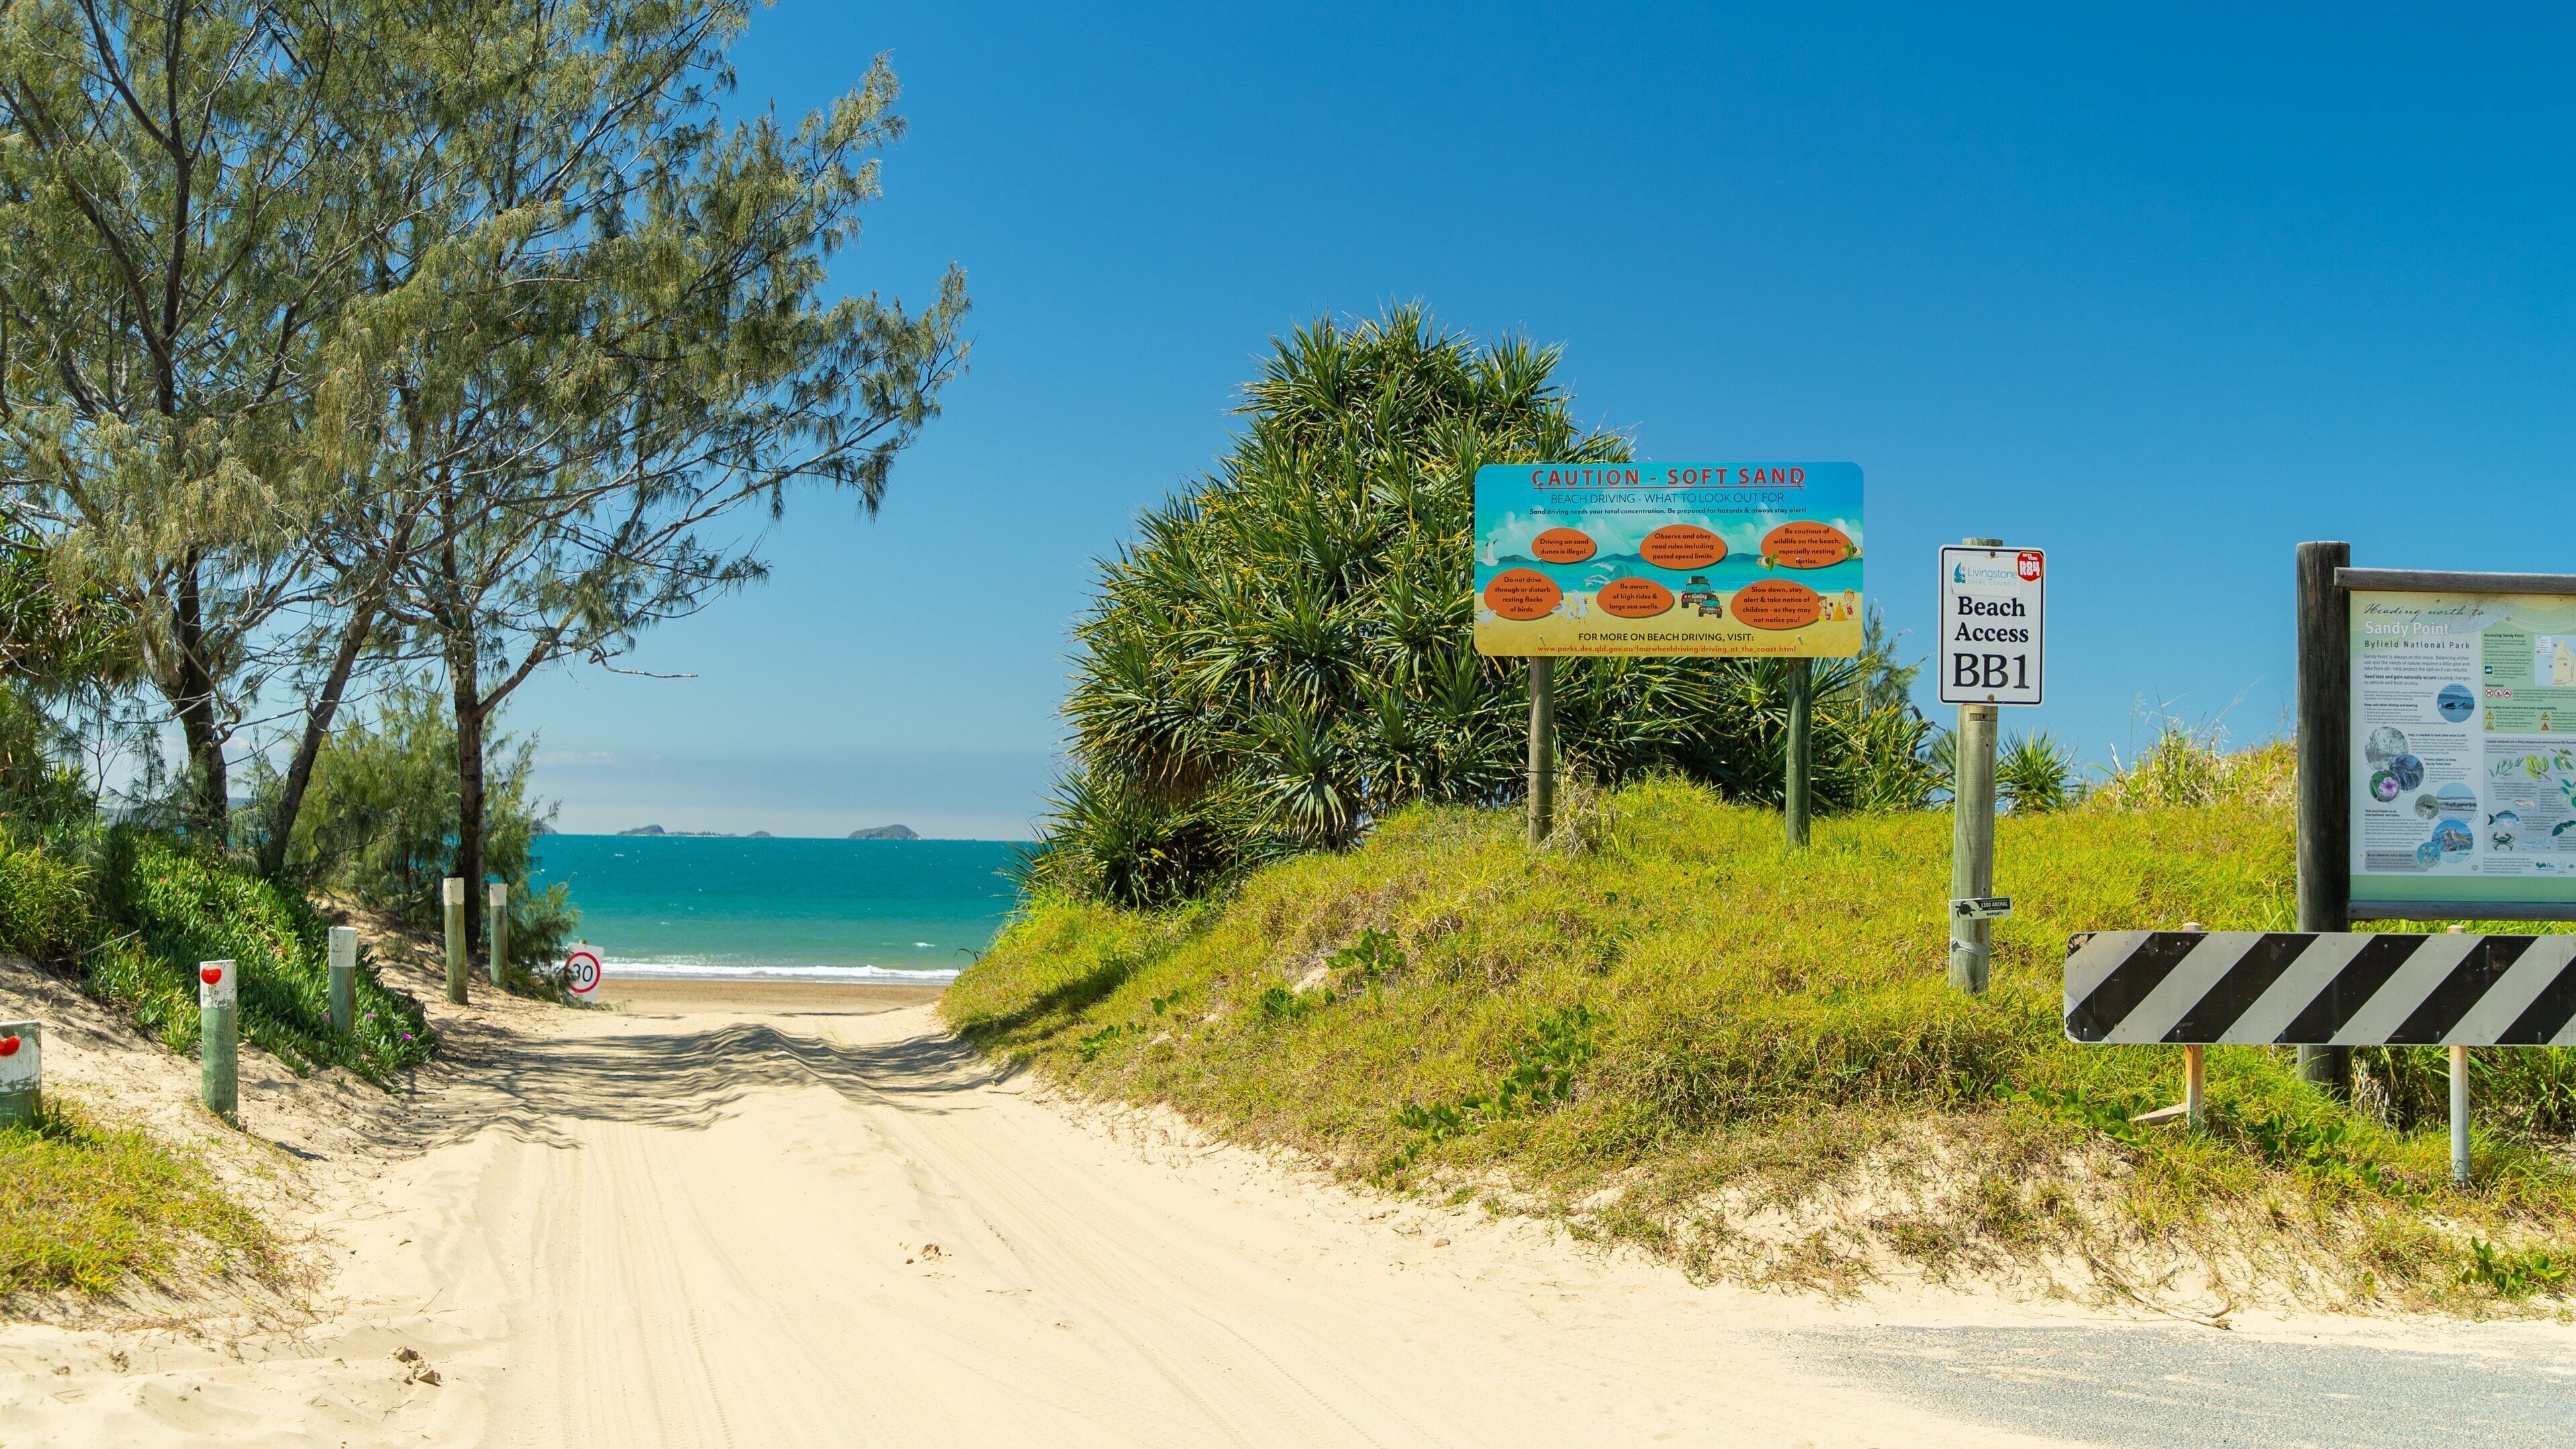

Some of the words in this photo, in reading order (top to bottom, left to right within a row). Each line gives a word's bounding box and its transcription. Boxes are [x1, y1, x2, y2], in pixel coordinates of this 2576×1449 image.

[1532, 470, 1639, 486] CAUTION
[1667, 468, 1728, 484] SOFT
[1738, 468, 1805, 484] SAND
[1552, 494, 1587, 503] BEACH
[1591, 494, 1635, 503] DRIVING
[1644, 494, 1678, 502] WHAT
[1680, 494, 1696, 502] TO
[1700, 494, 1730, 502] LOOK
[1733, 493, 1759, 502] OUT
[1762, 493, 1784, 502] FOR
[1696, 532, 1711, 540] obey
[1795, 557, 1818, 565] turtles.
[1968, 567, 2018, 580] Livingstone
[2019, 561, 2040, 576] R84
[1789, 586, 1802, 594] stay
[1958, 596, 2025, 616] Beach
[2364, 604, 2422, 623] Heading
[2428, 606, 2466, 615] north
[2470, 608, 2484, 616] to
[1955, 622, 2029, 643] Access
[2365, 621, 2408, 637] Sandy
[2413, 622, 2449, 635] Point
[1682, 633, 1725, 641] DRIVING,
[1538, 645, 1796, 653] www.parks.des.qld.gov.au/fourwheeldriving/driving_at_the_coast.html
[2365, 640, 2398, 649] Byfield
[1953, 653, 2030, 688] BB1
[573, 963, 593, 982] 30
